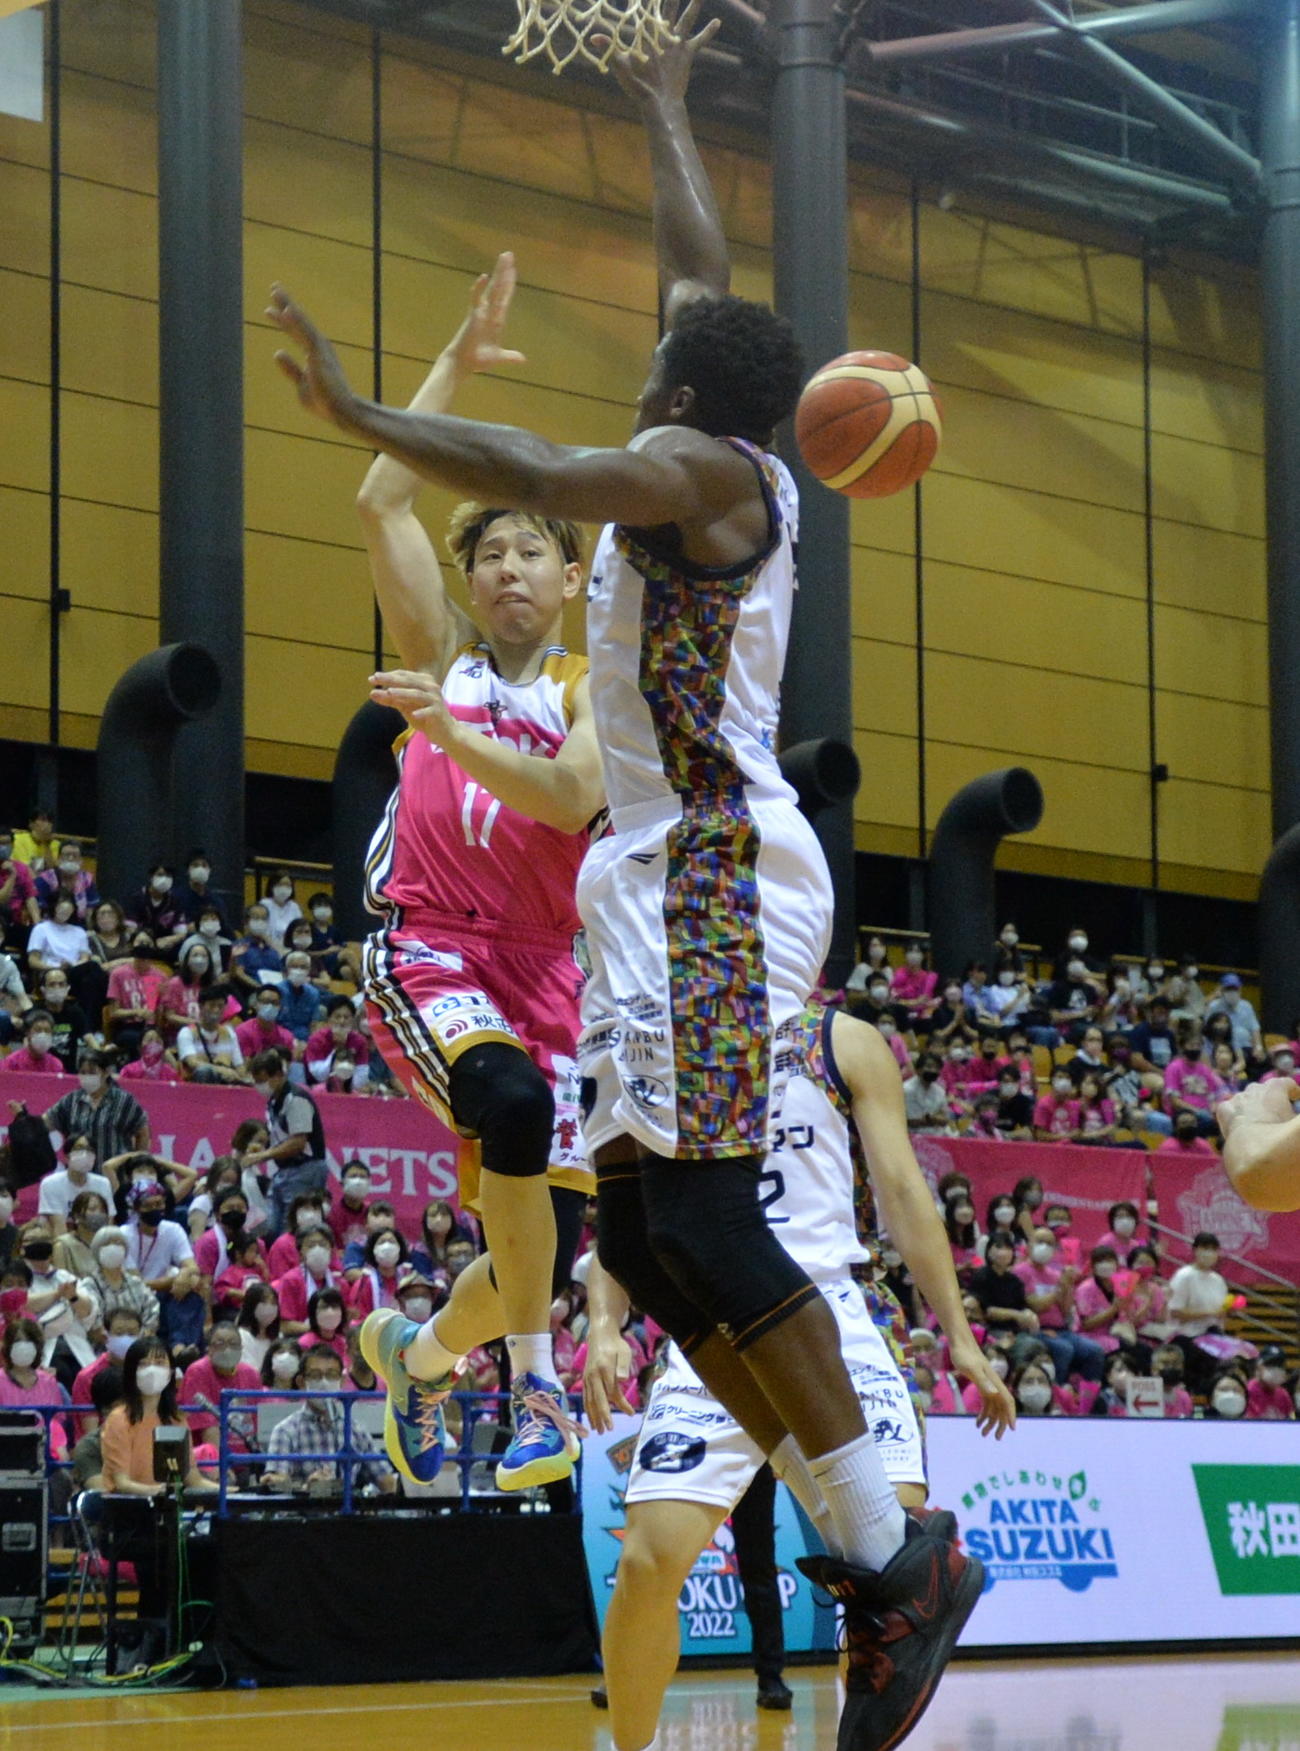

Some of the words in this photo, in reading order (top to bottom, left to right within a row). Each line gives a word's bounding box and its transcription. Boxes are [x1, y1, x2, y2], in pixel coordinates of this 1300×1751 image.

[990, 1499, 1079, 1524] AKITA
[965, 1528, 1115, 1561] SUZUKI
[1227, 1502, 1300, 1559] 秋田
[688, 1612, 736, 1637] 2022
